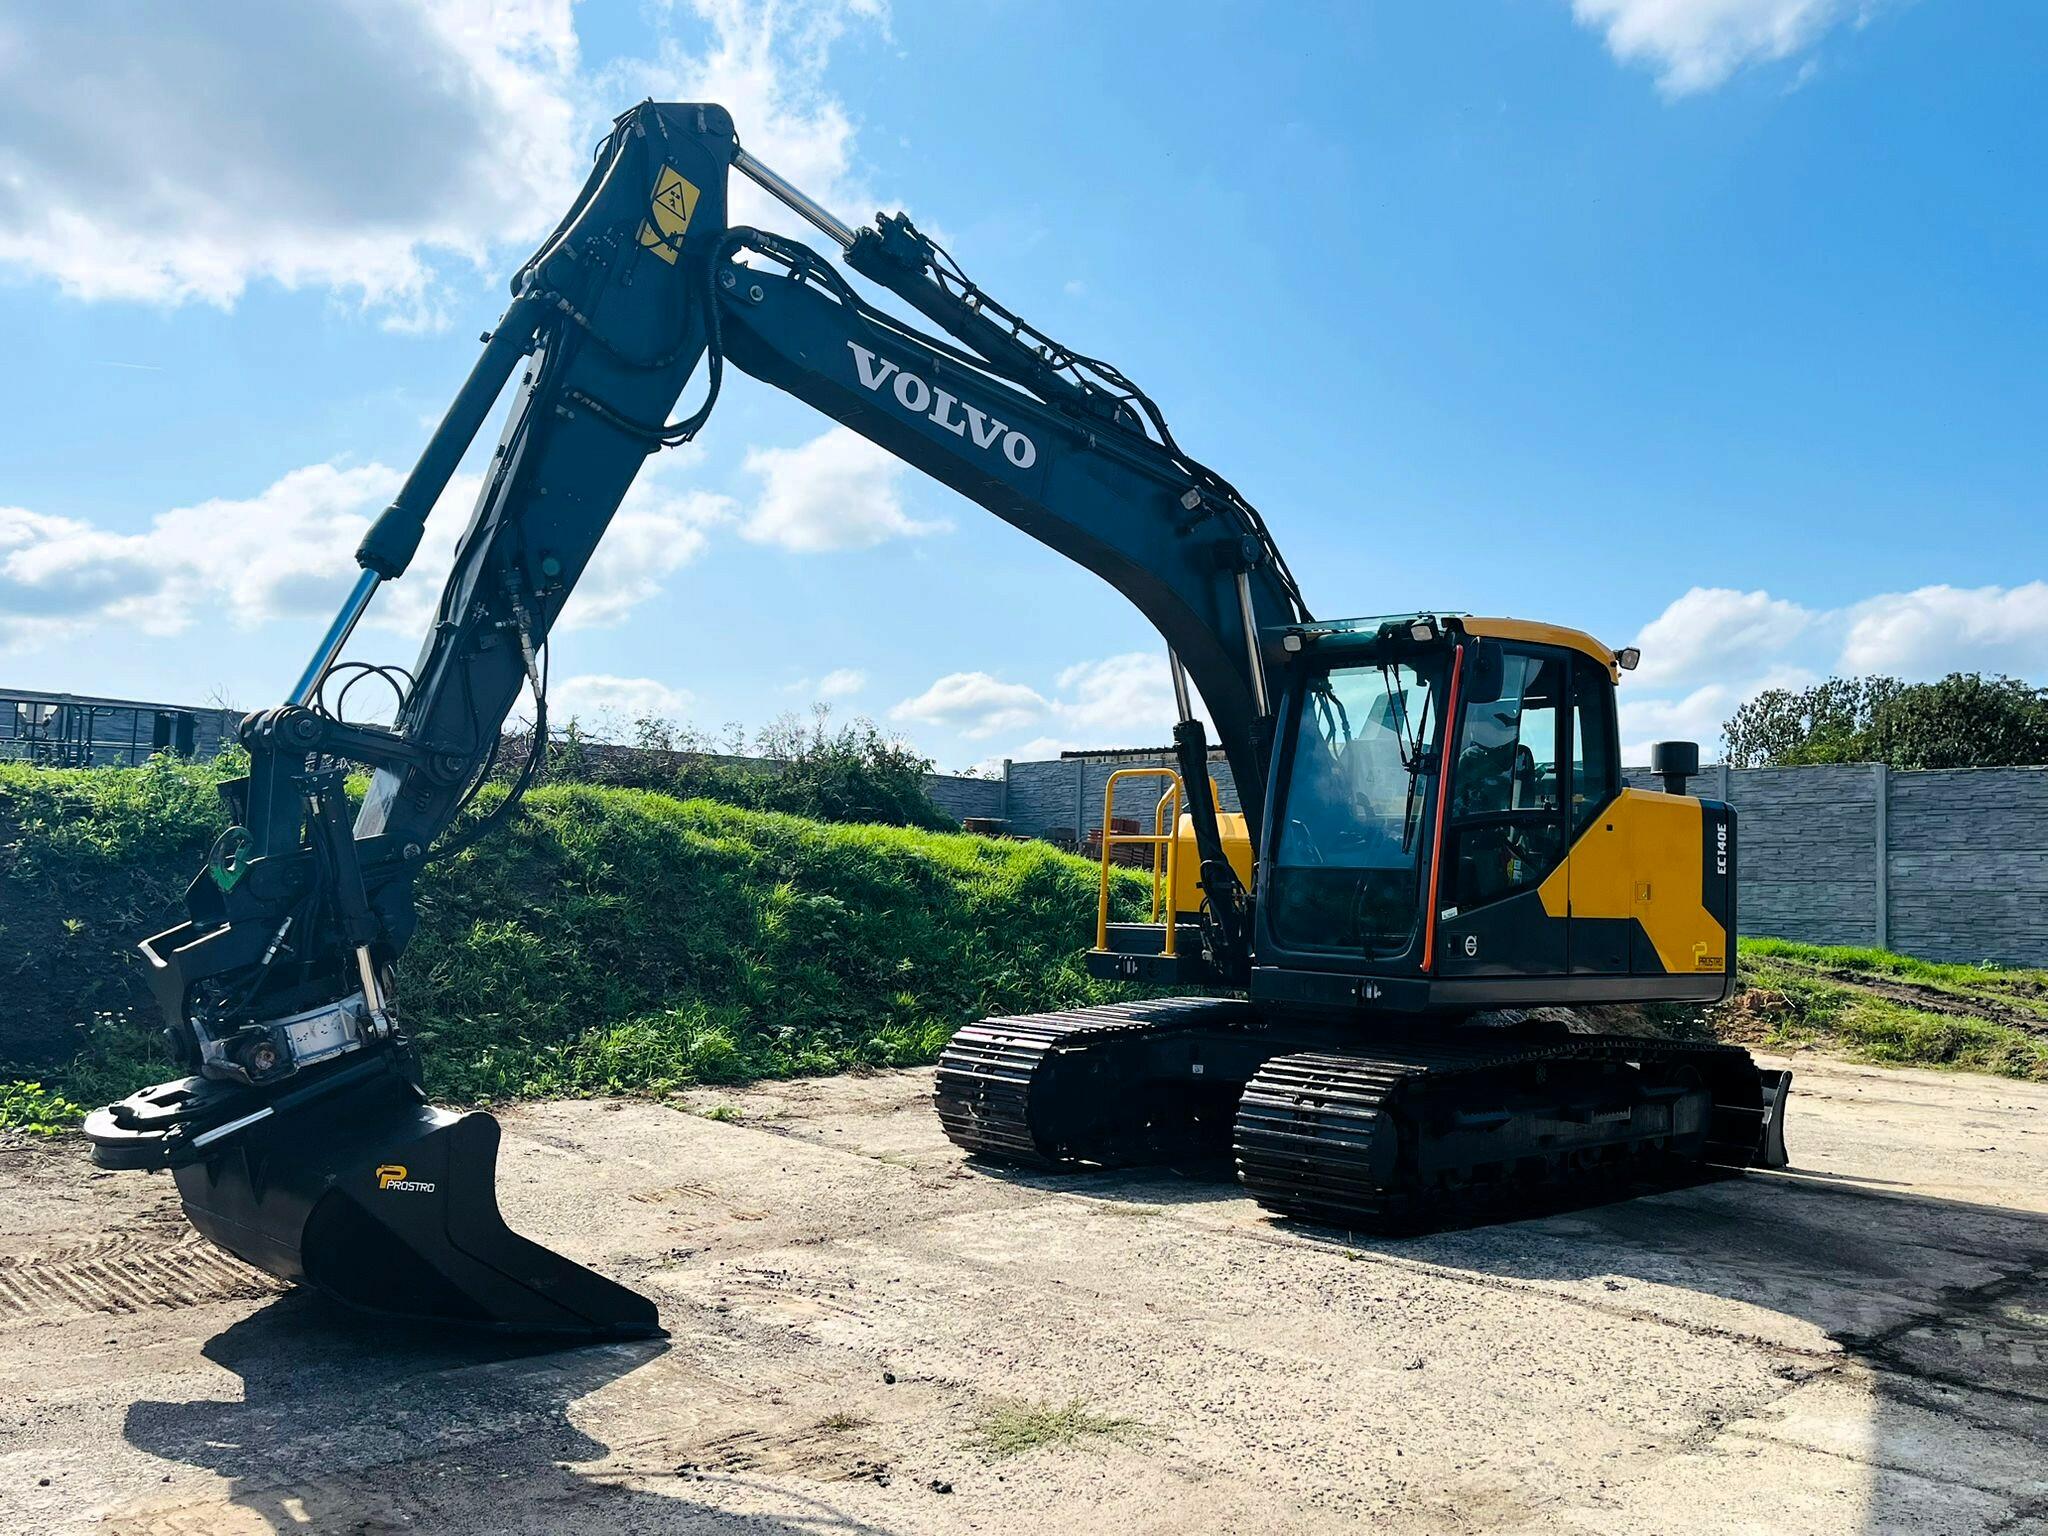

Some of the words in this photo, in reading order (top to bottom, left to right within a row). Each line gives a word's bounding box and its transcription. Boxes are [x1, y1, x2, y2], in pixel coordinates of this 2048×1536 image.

[847, 340, 1037, 469] VOLVO
[1717, 823, 1727, 875] EC140E
[386, 1180, 435, 1193] PROSTRO
